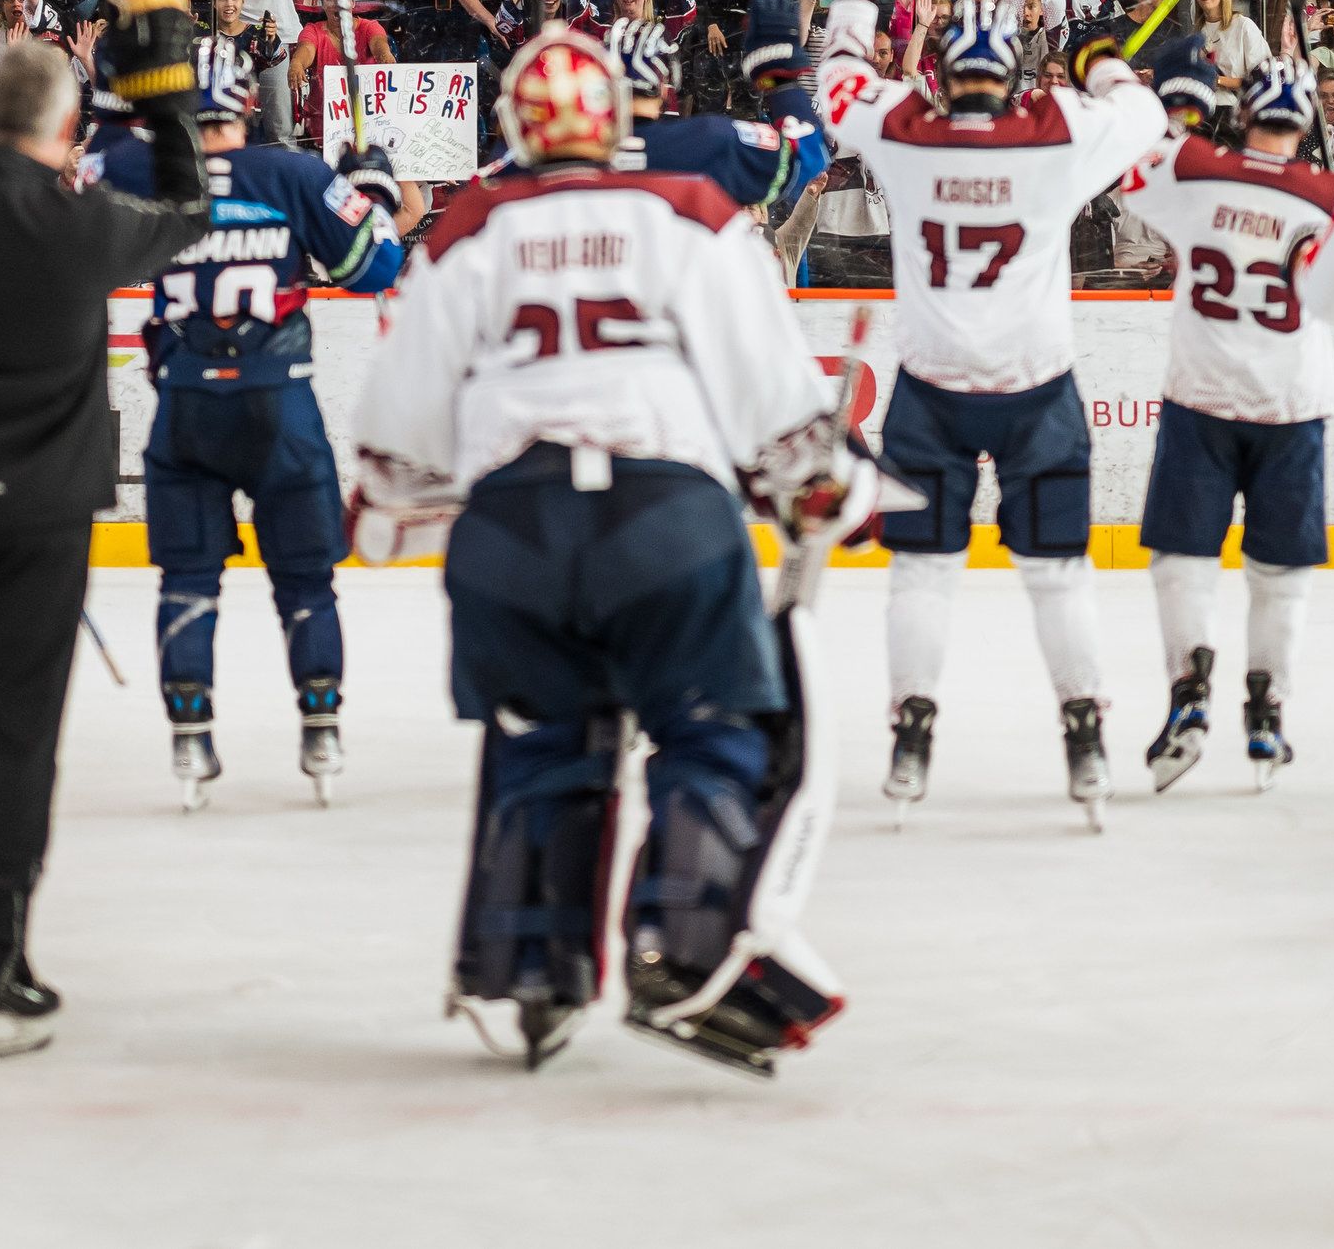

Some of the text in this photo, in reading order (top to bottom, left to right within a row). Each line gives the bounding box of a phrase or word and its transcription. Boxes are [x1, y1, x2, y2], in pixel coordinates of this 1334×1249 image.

[327, 92, 387, 121] IMER
[921, 220, 1025, 288] 17
[1191, 245, 1302, 333] 23
